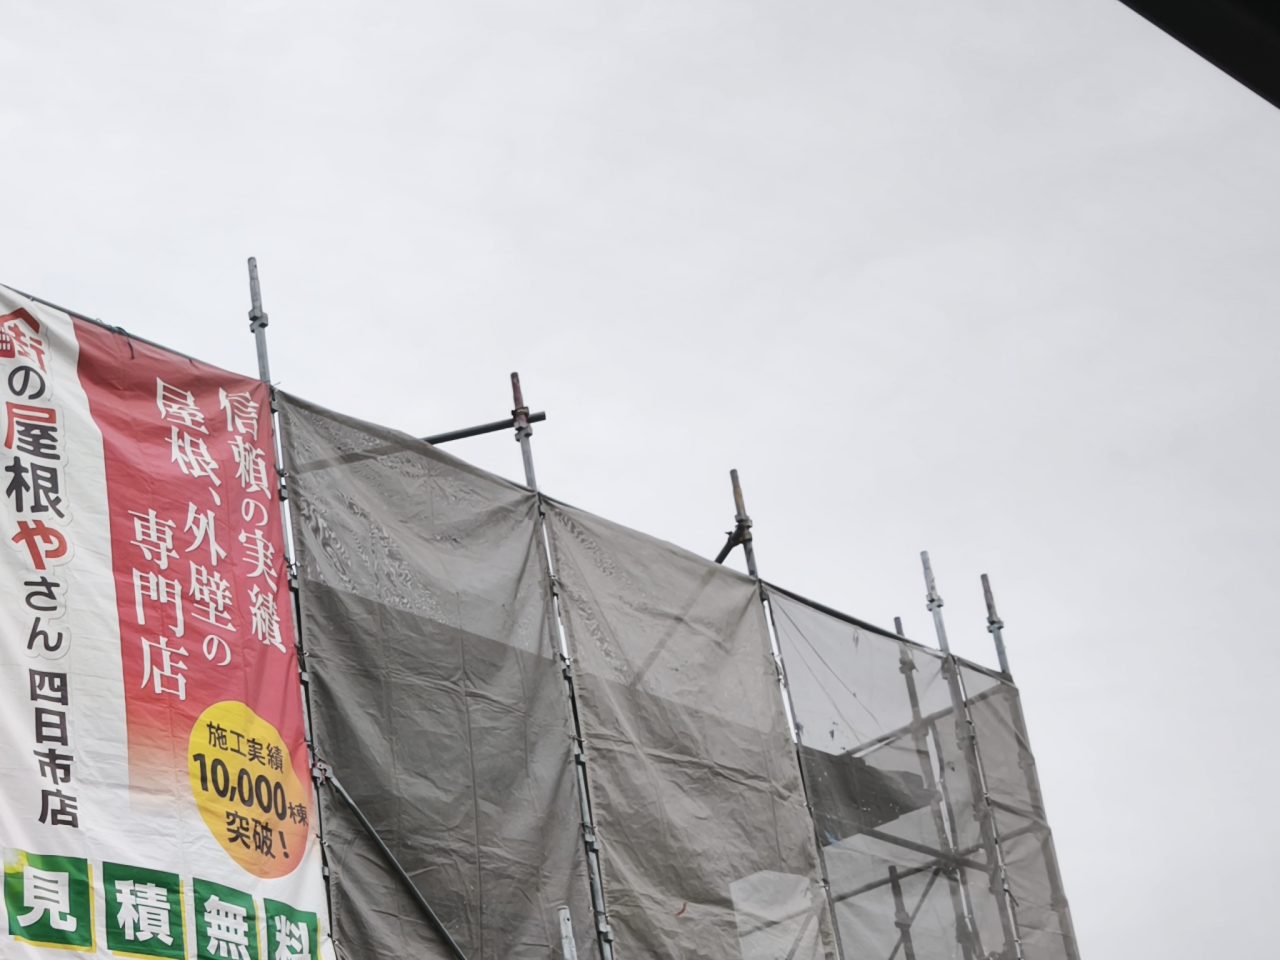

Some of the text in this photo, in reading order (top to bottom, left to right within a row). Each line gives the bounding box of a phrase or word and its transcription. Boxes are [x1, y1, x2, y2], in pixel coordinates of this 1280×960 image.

[219, 386, 286, 653] 信頼の実績
[128, 508, 189, 700] 専門店
[29, 668, 79, 828] 四日市店
[206, 721, 283, 774] 施工実績
[226, 810, 290, 859] 突破！
